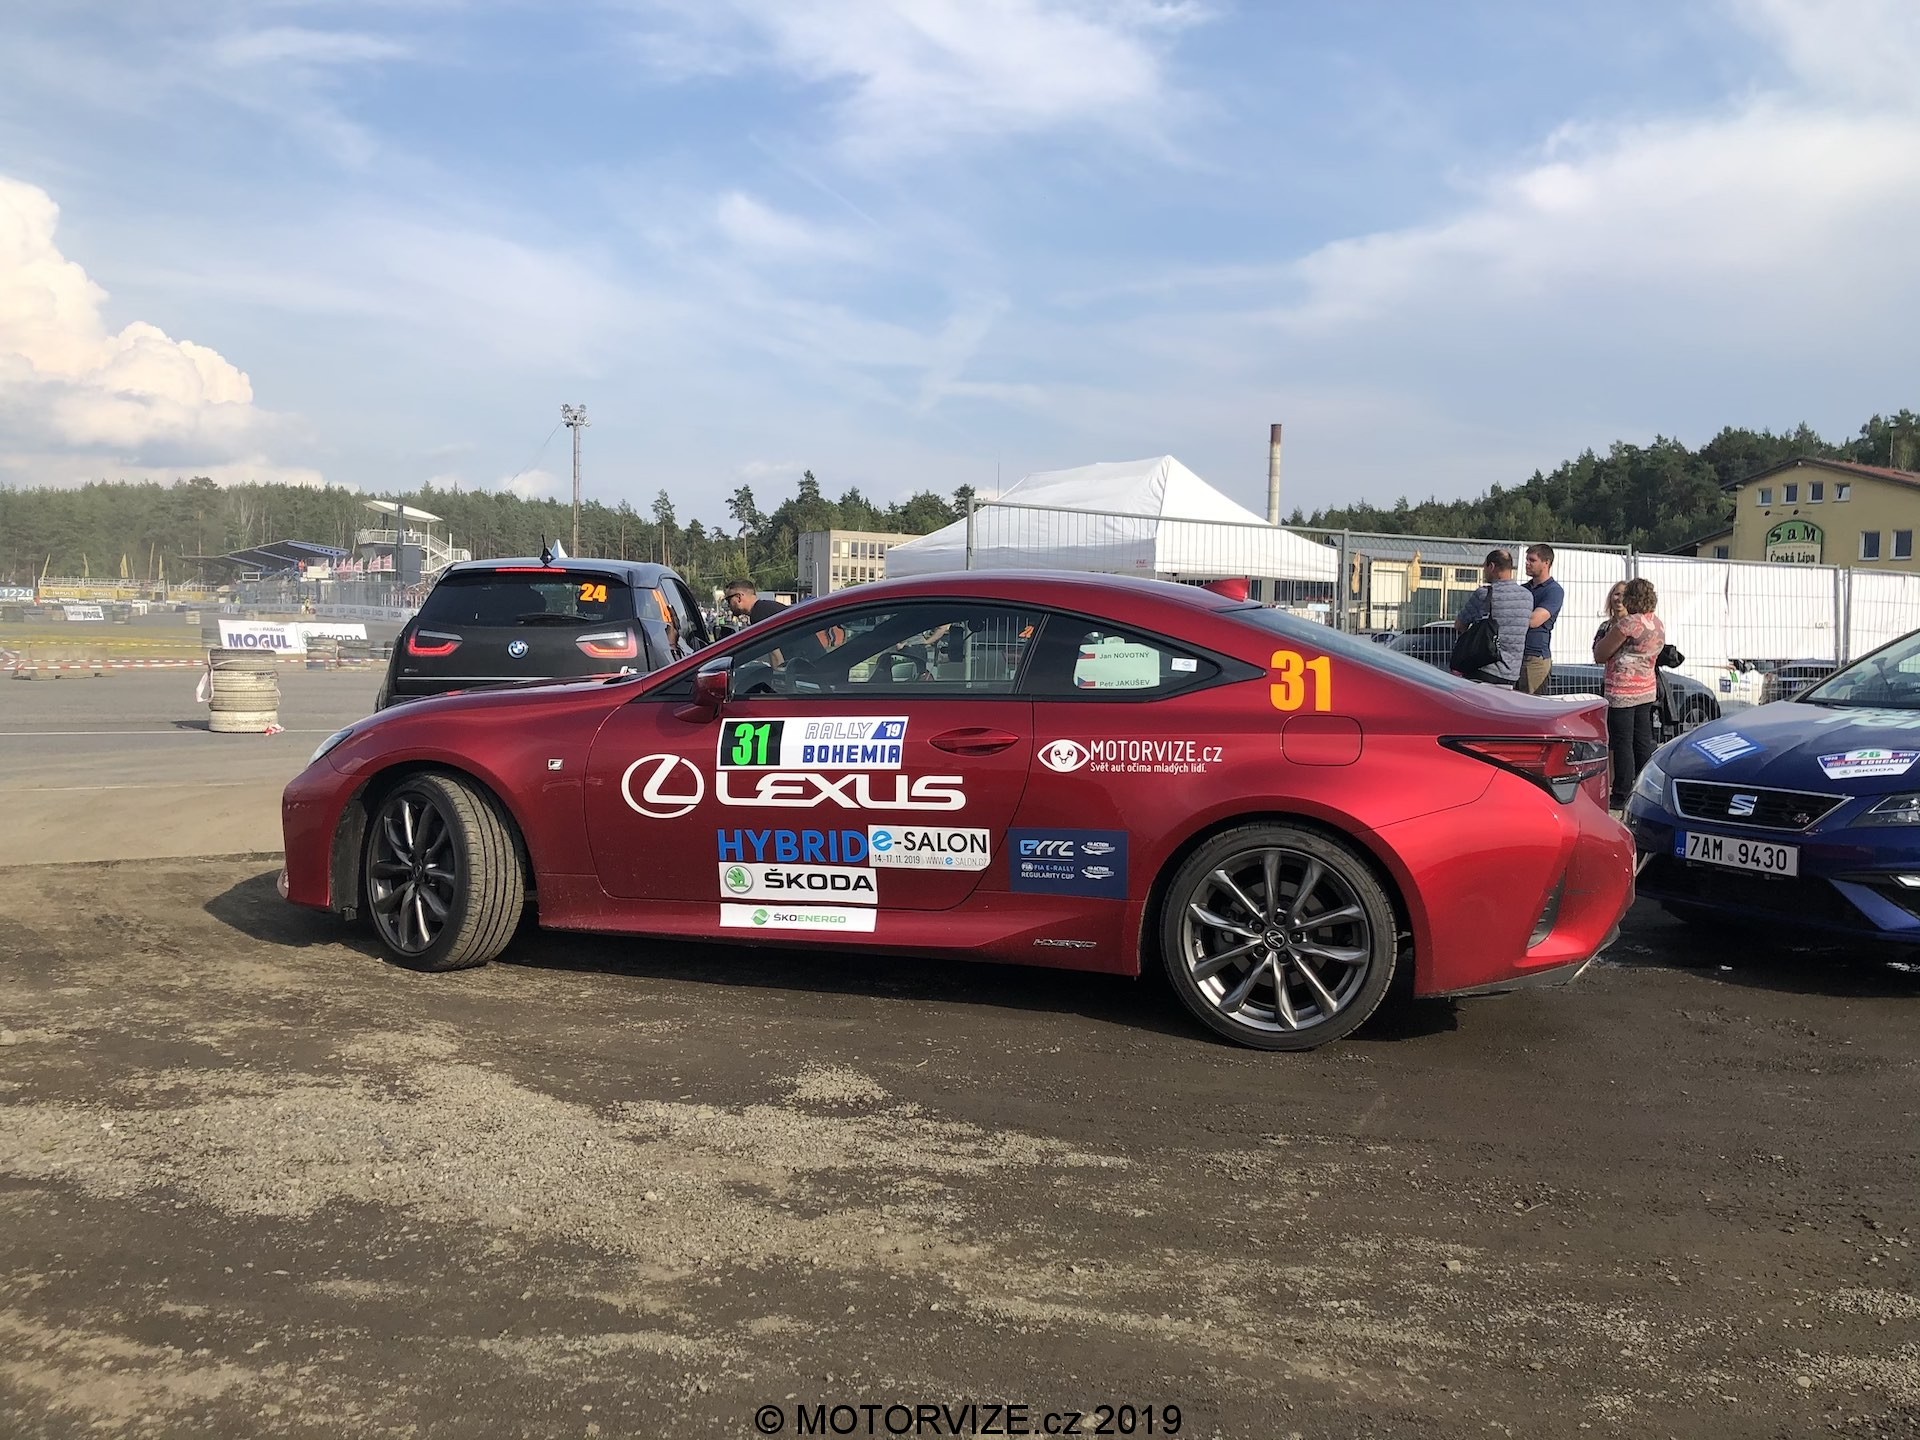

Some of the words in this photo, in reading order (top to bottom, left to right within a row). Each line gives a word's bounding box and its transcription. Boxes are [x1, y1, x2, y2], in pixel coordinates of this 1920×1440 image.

[1770, 551, 1795, 563] Česká
[1797, 551, 1815, 564] Lípa
[580, 584, 607, 602] 24
[227, 633, 293, 649] MOGUL
[1099, 652, 1112, 660] Jan
[1113, 651, 1150, 660] NOVOTNÝ
[1115, 678, 1151, 688] JAKUŠEV
[1269, 649, 1332, 712] 31
[804, 722, 873, 740] RALLY
[731, 723, 772, 766] 31
[1090, 740, 1223, 763] MOTORVIZE.cz
[802, 744, 901, 764] BOHEMIA
[1857, 751, 1881, 759] 26
[1860, 758, 1911, 766] BOHEMIA
[1090, 762, 1110, 772] Svět
[1110, 763, 1125, 773] aut
[1127, 763, 1152, 773] očima
[1153, 763, 1189, 776] mladých
[715, 771, 967, 811] LEXUS
[717, 828, 868, 863] HYBRID
[871, 830, 987, 854] e-SALON
[1676, 845, 1685, 855] CZ
[904, 855, 920, 865] 2019
[1690, 835, 1723, 862] 7AM
[1738, 843, 1788, 871] 9430
[1021, 871, 1060, 879] REGULARITY
[1045, 863, 1075, 872] E-RALLY
[764, 868, 875, 892] ŠKODA
[773, 912, 847, 924] ŠKOENERGO
